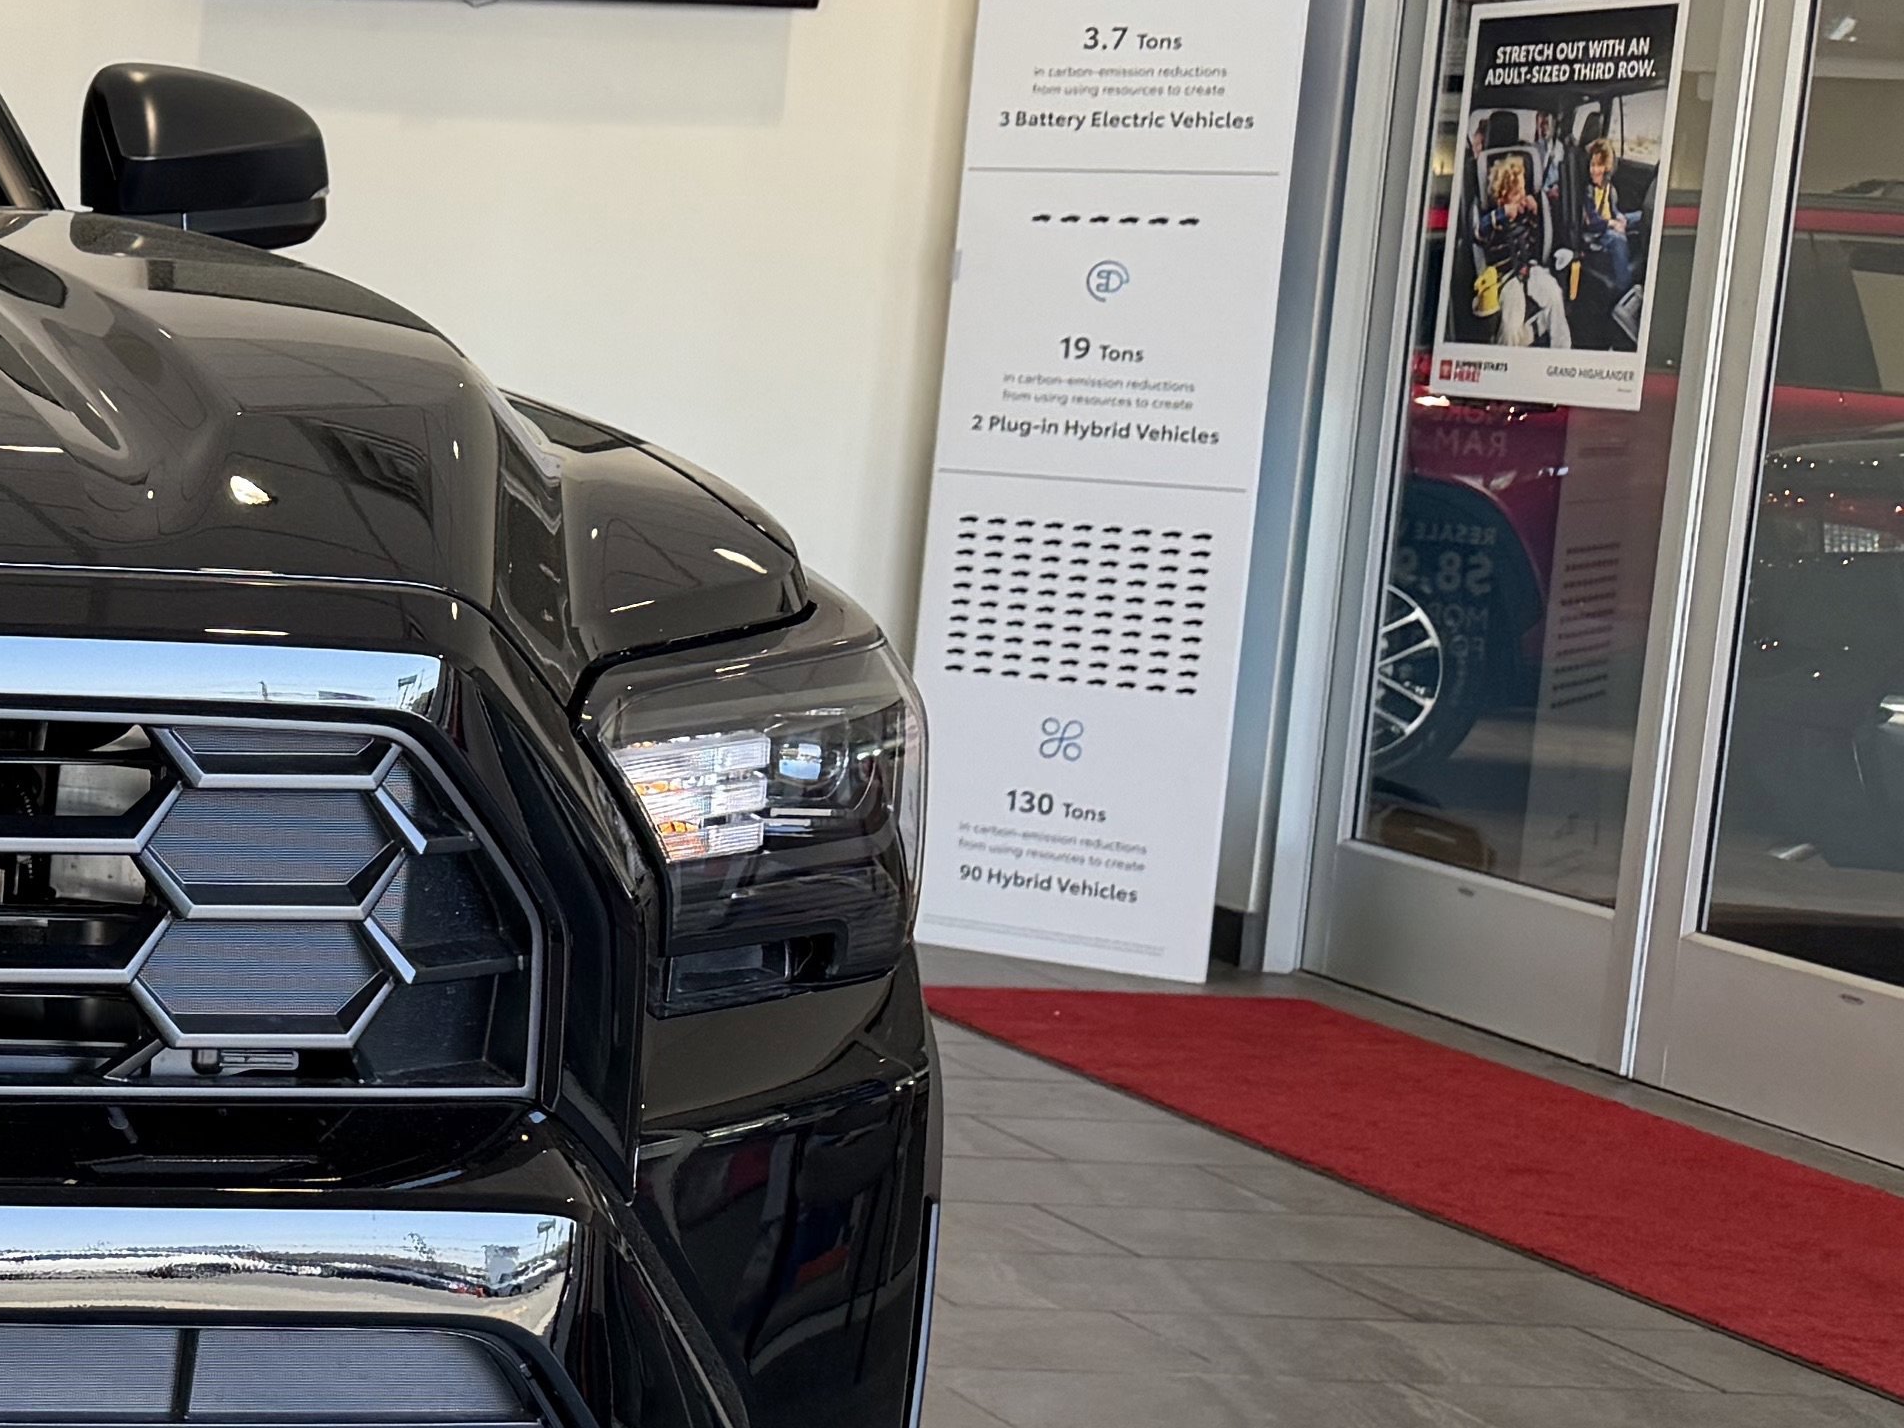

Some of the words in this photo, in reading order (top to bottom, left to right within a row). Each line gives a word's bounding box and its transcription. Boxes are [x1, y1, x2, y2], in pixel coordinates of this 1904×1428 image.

[1083, 27, 1128, 51] 3.7
[1136, 34, 1183, 51] Tons
[1496, 43, 1553, 64] STRETCH
[1556, 40, 1586, 61] OUT
[1588, 38, 1625, 58] WITH
[1627, 37, 1650, 56] AN
[1485, 65, 1570, 86] ADULT-SIZED
[1573, 61, 1614, 81] THIRD
[1618, 59, 1657, 78] ROW.
[999, 112, 1010, 127] 3
[1015, 112, 1086, 131] Battery
[1091, 111, 1164, 129] Electric
[1170, 111, 1254, 130] Vehicles
[1060, 336, 1090, 360] 19
[1099, 344, 1144, 362] Tons
[1546, 366, 1578, 378] GRAND
[1579, 366, 1635, 382] HIGHLANDER
[971, 415, 983, 431] 2
[988, 415, 1059, 438] Plug-in
[1064, 419, 1131, 441] Hybrid
[1137, 423, 1220, 445] Vehicles
[1007, 789, 1054, 816] 130
[1063, 802, 1107, 823] Tons
[960, 865, 982, 882] 90
[987, 867, 1052, 893] Hybrid
[1057, 877, 1138, 903] Vehicles
